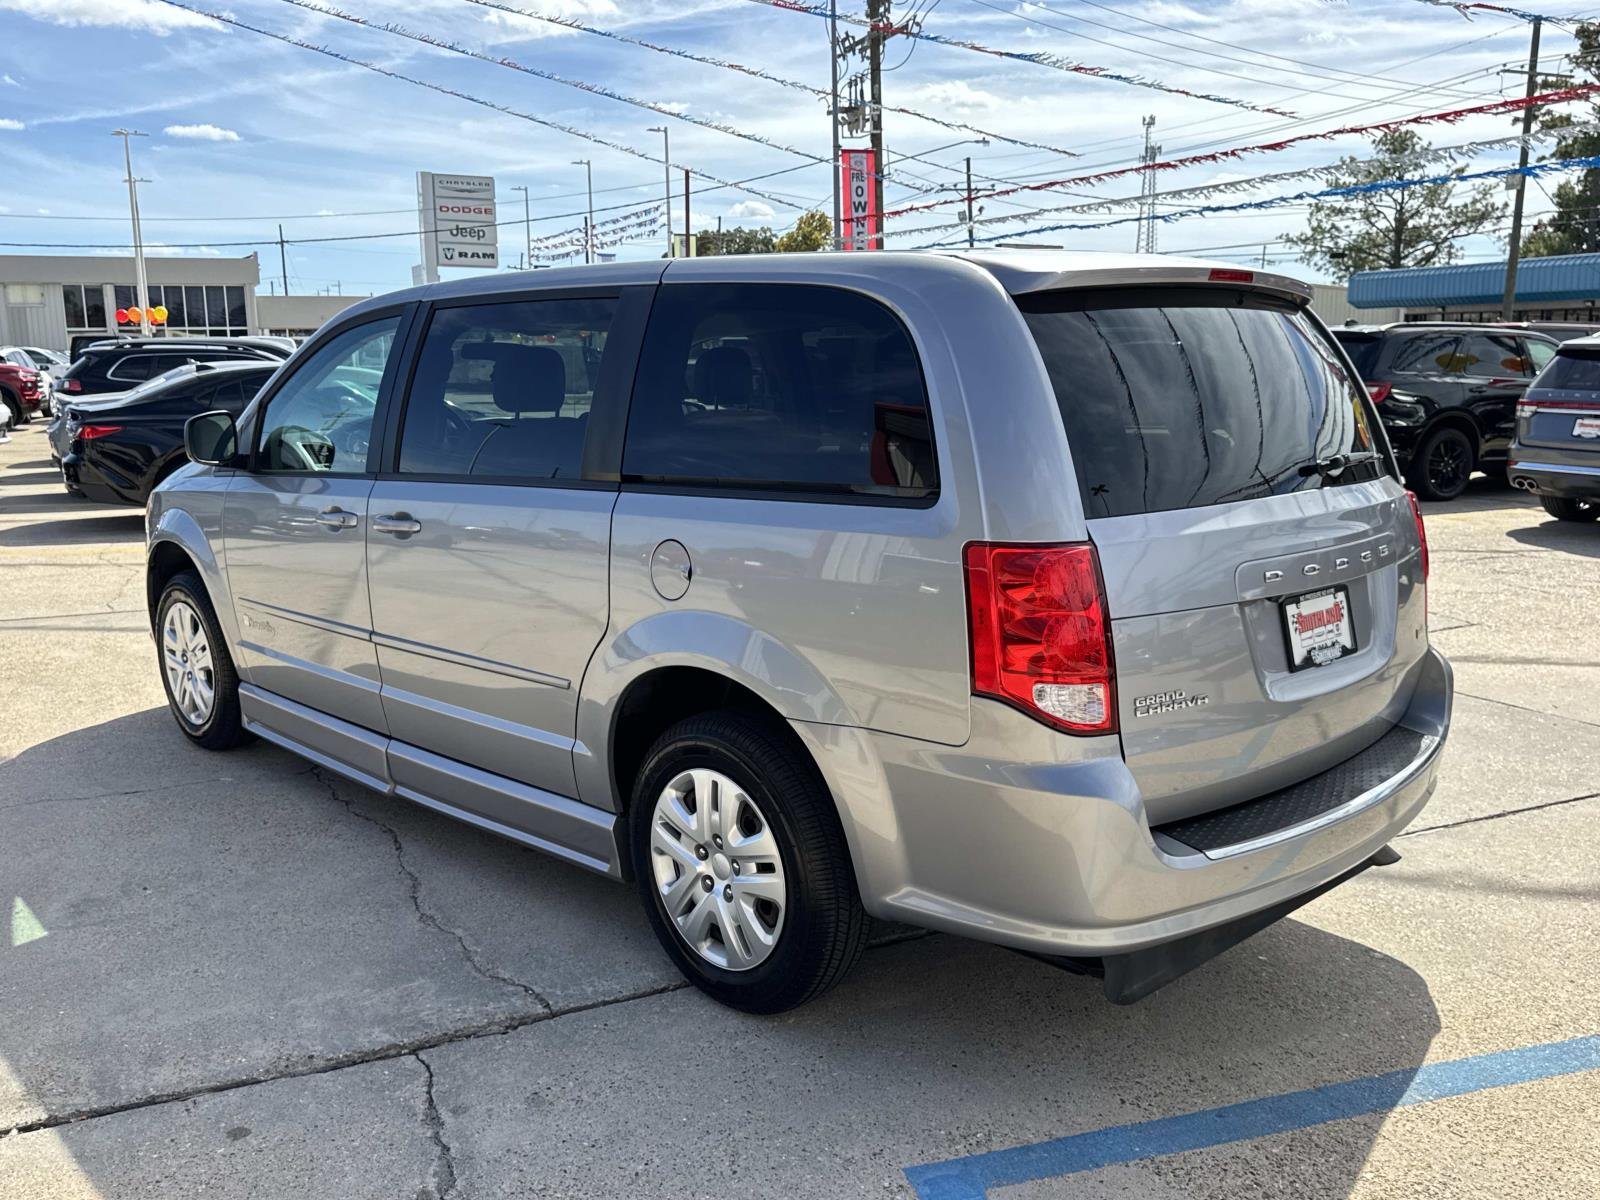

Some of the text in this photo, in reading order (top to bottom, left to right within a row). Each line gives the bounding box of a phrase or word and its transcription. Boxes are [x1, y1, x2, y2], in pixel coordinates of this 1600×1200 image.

[439, 205, 493, 215] DODGE
[449, 224, 486, 240] Jeep
[458, 251, 495, 259] RAM
[1264, 545, 1389, 583] DODGE
[1134, 690, 1186, 707] GRAND
